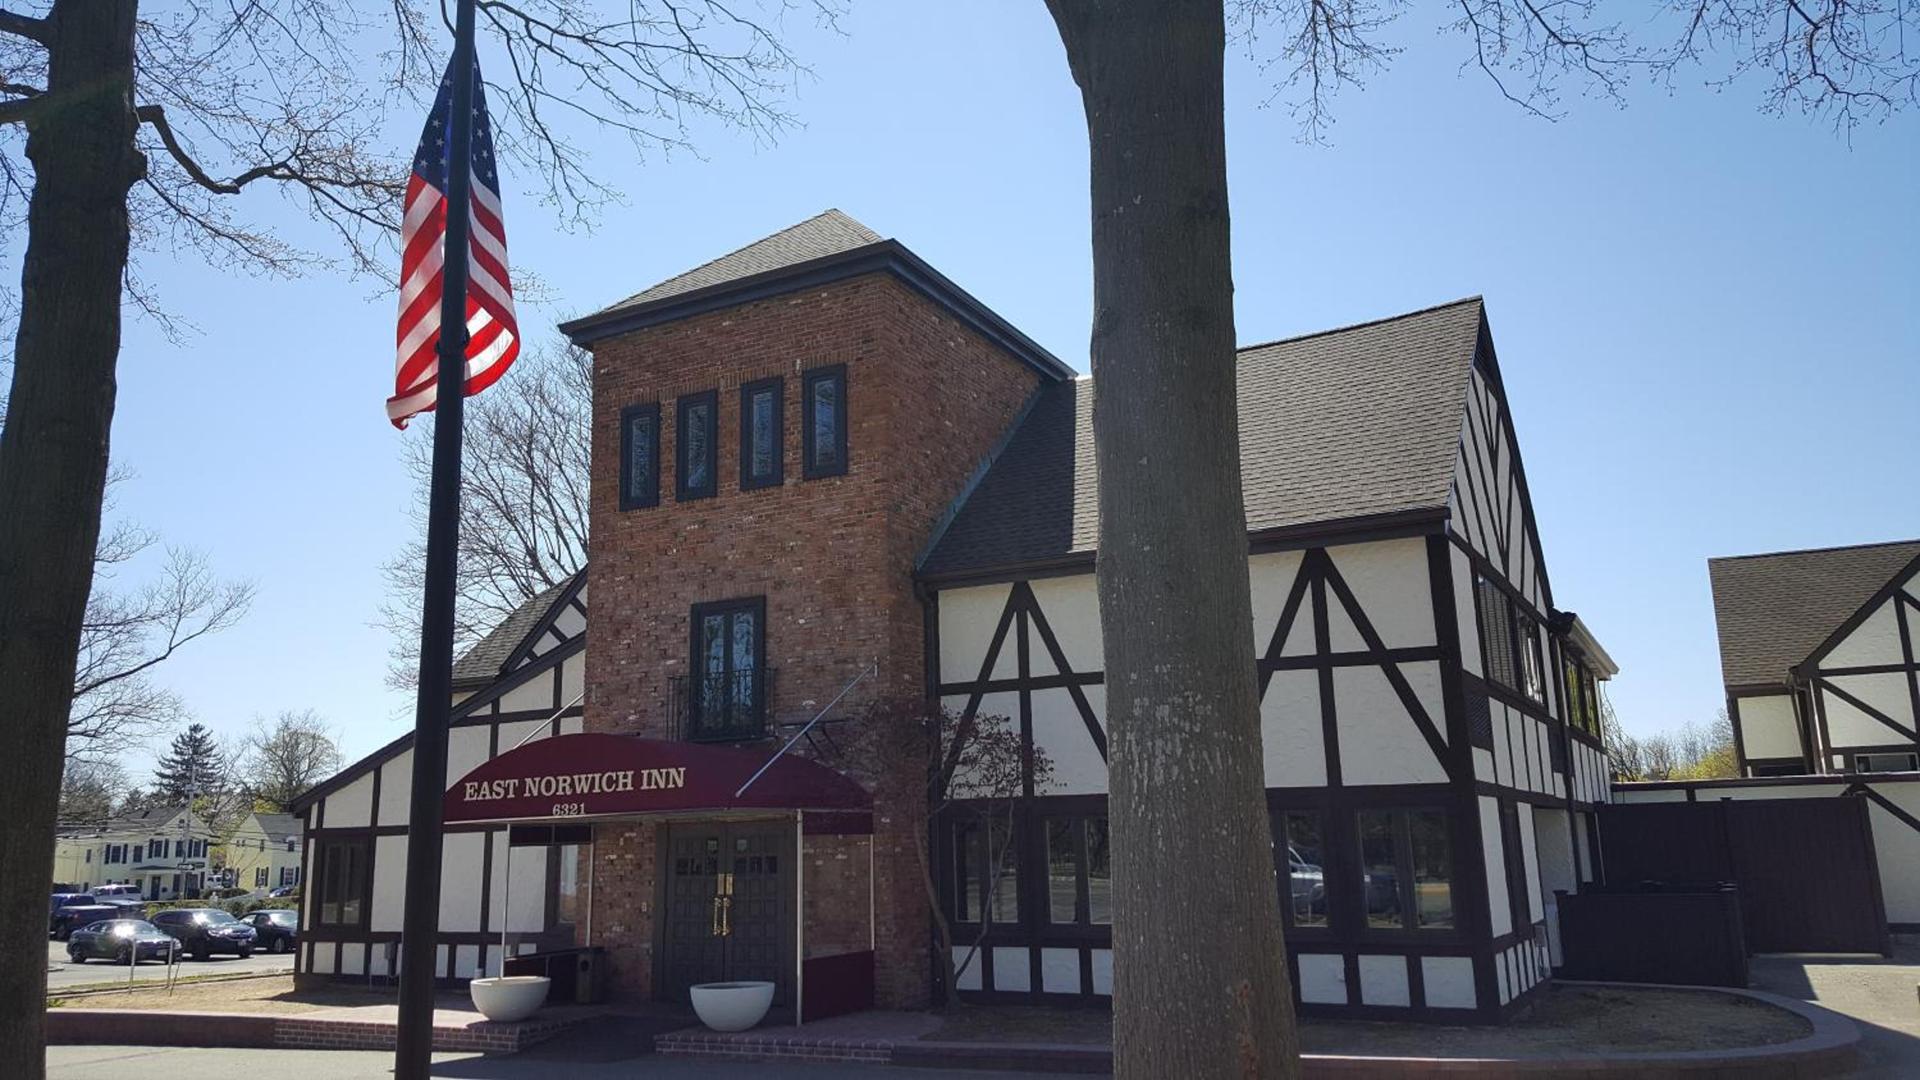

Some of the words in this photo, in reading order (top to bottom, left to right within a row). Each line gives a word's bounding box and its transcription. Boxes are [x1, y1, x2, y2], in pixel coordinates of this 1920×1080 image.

[464, 779, 518, 801] EAST
[523, 771, 634, 797] NORWICH
[640, 767, 686, 790] INN
[552, 803, 586, 816] 6321
